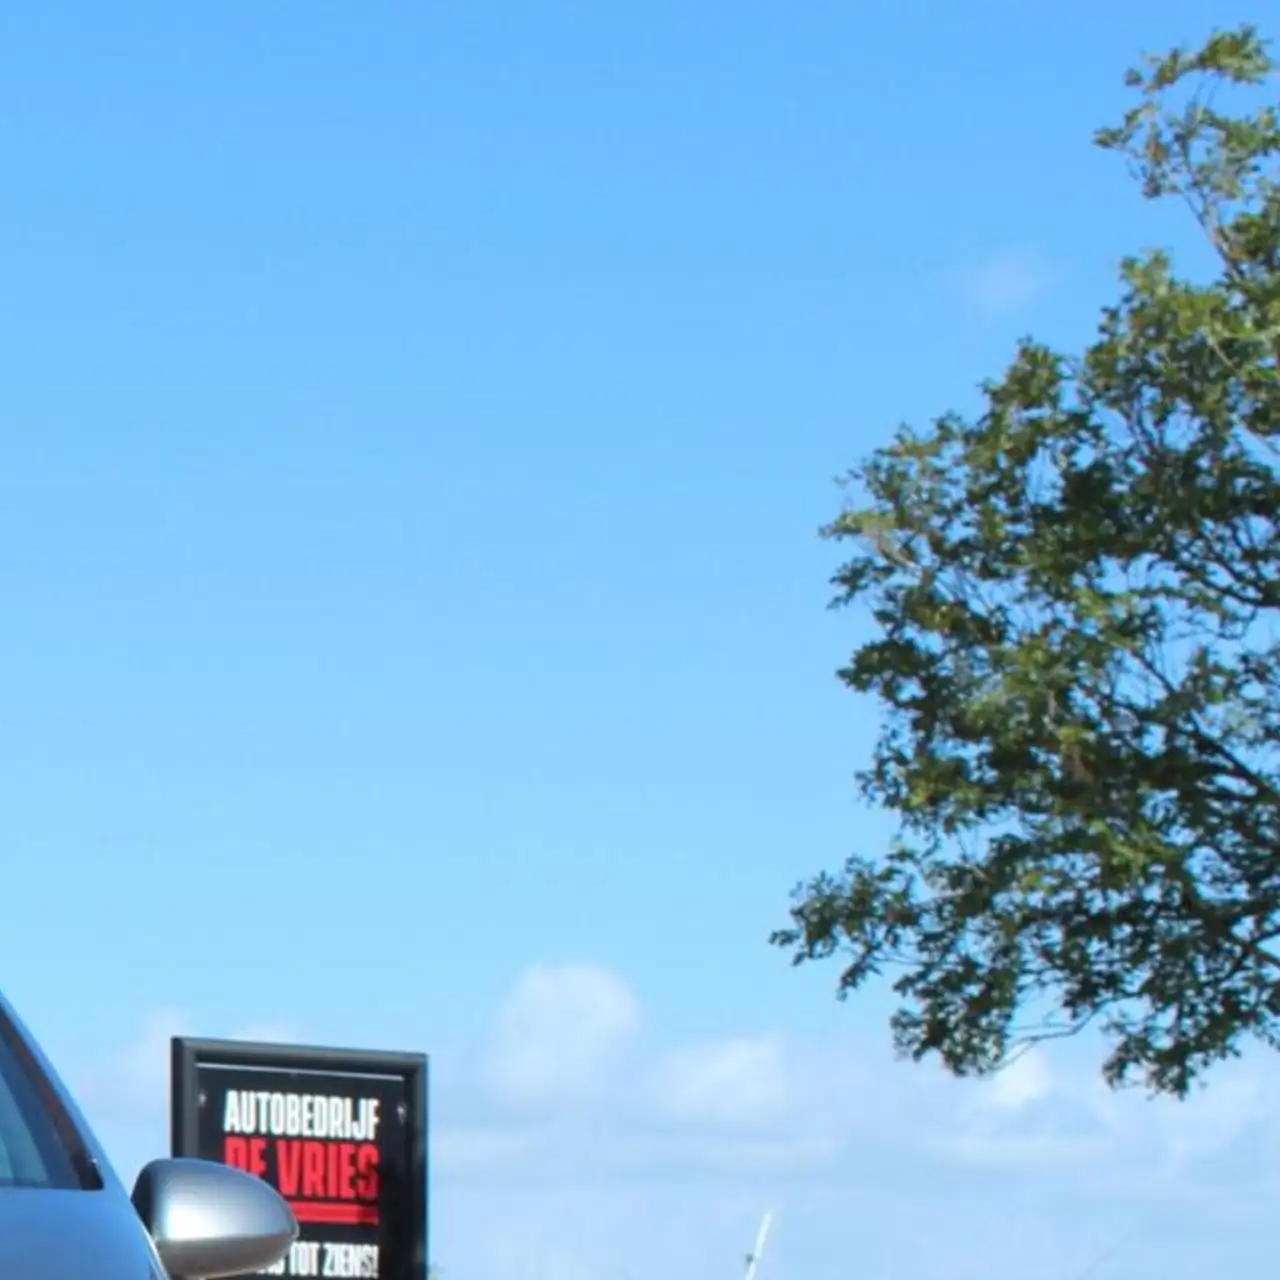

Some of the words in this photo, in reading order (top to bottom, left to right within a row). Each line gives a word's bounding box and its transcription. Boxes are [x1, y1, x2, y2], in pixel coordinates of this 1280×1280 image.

[224, 1090, 380, 1140] AUTOBEDRIJF
[276, 1140, 379, 1199] VRIES
[322, 1243, 380, 1279] ZIENS!
